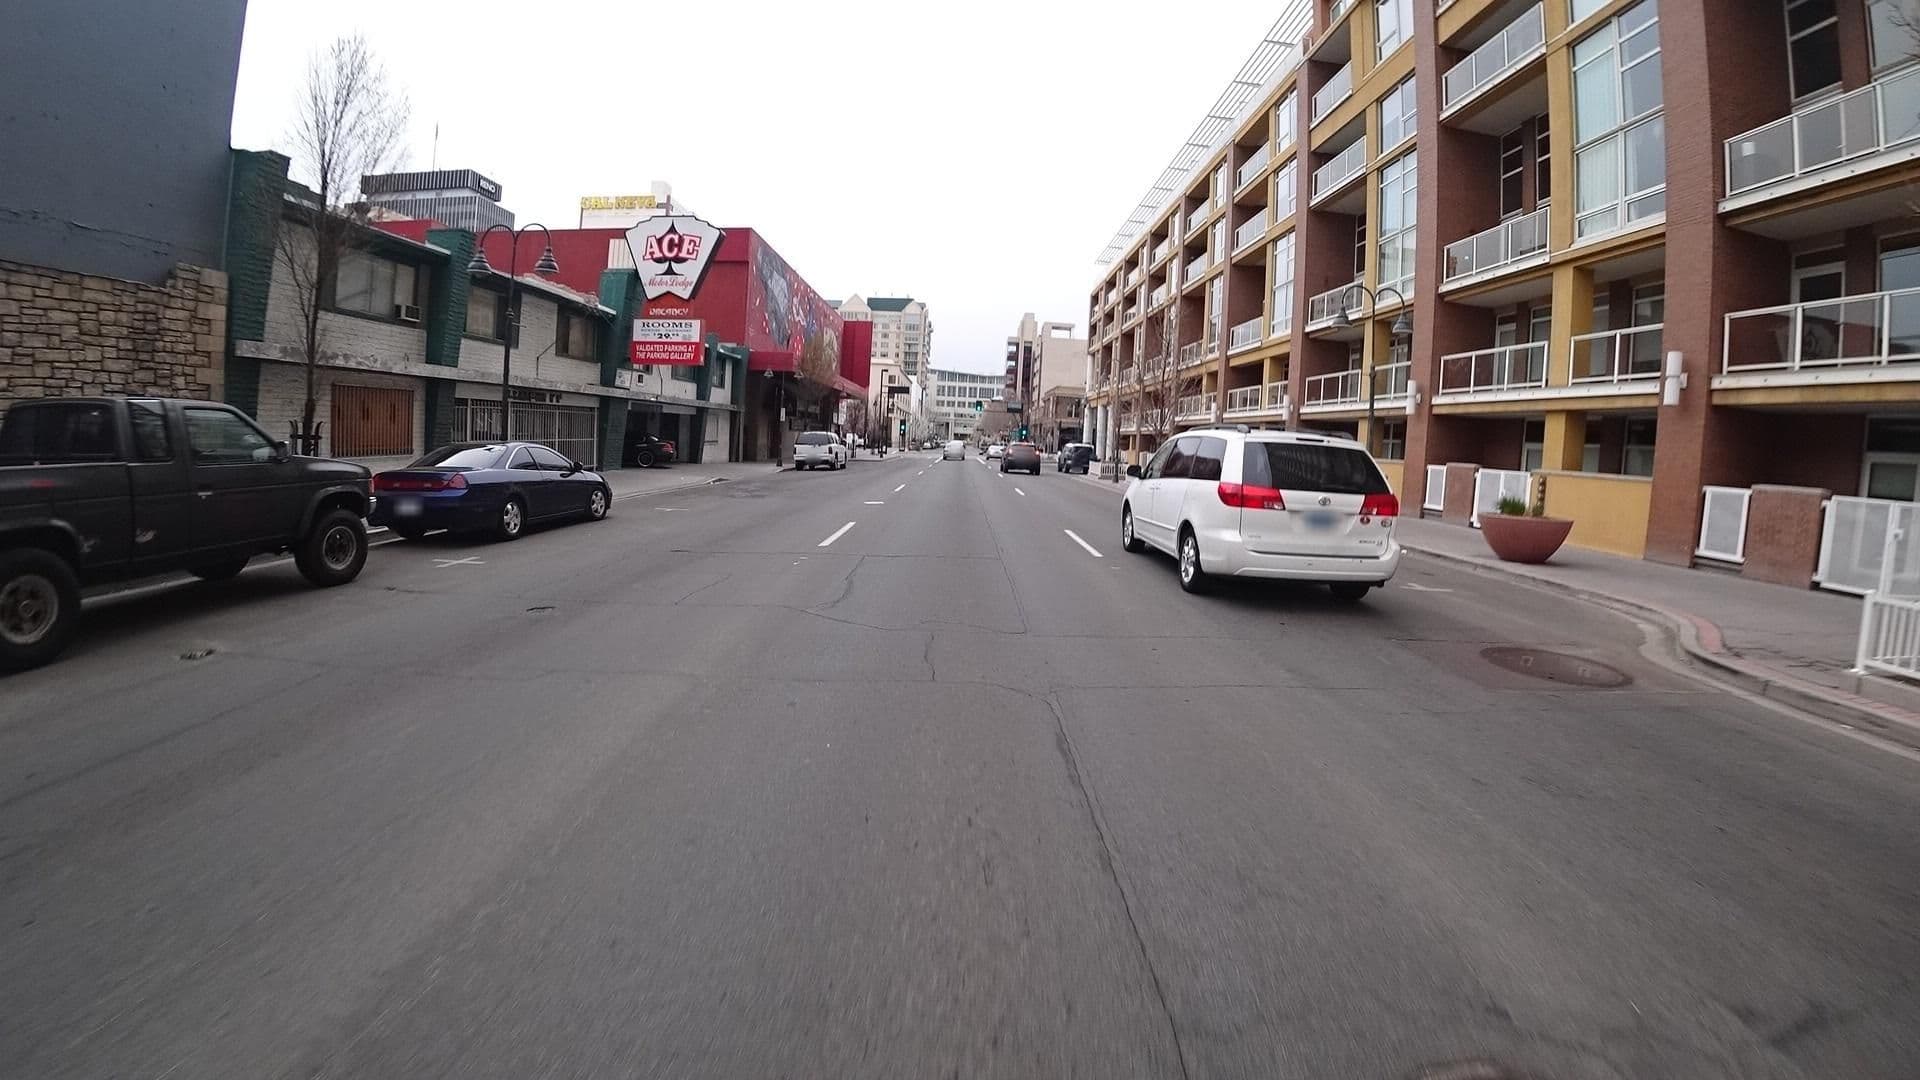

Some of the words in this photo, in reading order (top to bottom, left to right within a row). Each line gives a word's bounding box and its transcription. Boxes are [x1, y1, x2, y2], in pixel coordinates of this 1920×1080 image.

[643, 233, 702, 260] ACE
[636, 343, 663, 351] VALIDATED
[665, 344, 687, 352] PARKING
[688, 344, 695, 352] AT
[636, 351, 646, 359] THE
[670, 352, 694, 360] GALLERY
